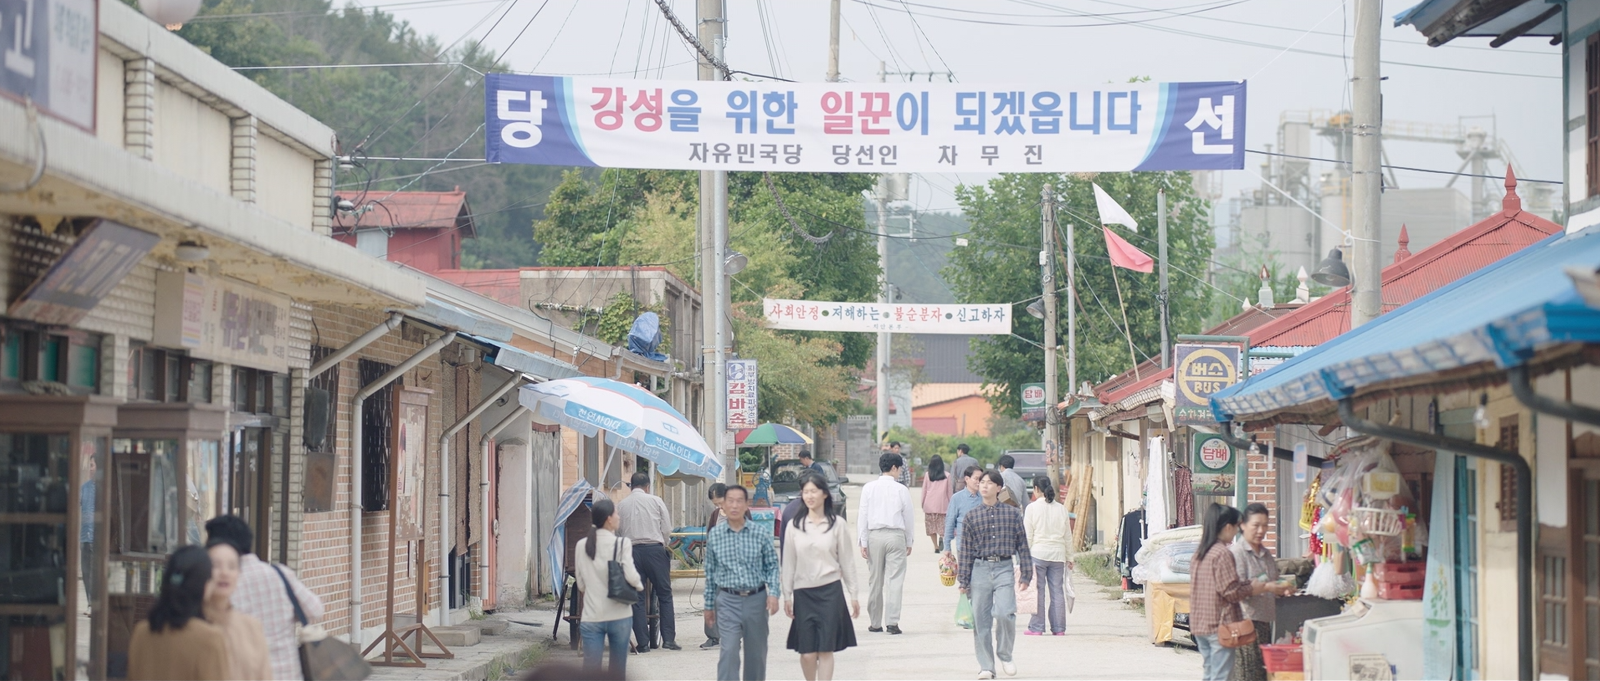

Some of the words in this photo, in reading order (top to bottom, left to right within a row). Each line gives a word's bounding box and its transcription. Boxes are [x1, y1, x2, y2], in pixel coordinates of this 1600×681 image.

[497, 90, 547, 148] 당
[590, 87, 702, 133] 강성을
[726, 90, 798, 135] 위한
[820, 91, 929, 136] 일꾼이
[1184, 94, 1235, 155] 선
[688, 142, 803, 165] 자유민국당
[832, 144, 898, 166] 당선인
[769, 303, 819, 320] 사회안정
[832, 306, 880, 322] 저해하는
[893, 306, 942, 323] 불순분자
[956, 307, 1006, 323] 신고하자
[1192, 363, 1223, 375] 버스
[1025, 389, 1042, 399] 담배
[1194, 382, 1220, 394] BUS
[1203, 447, 1228, 461] 담배
